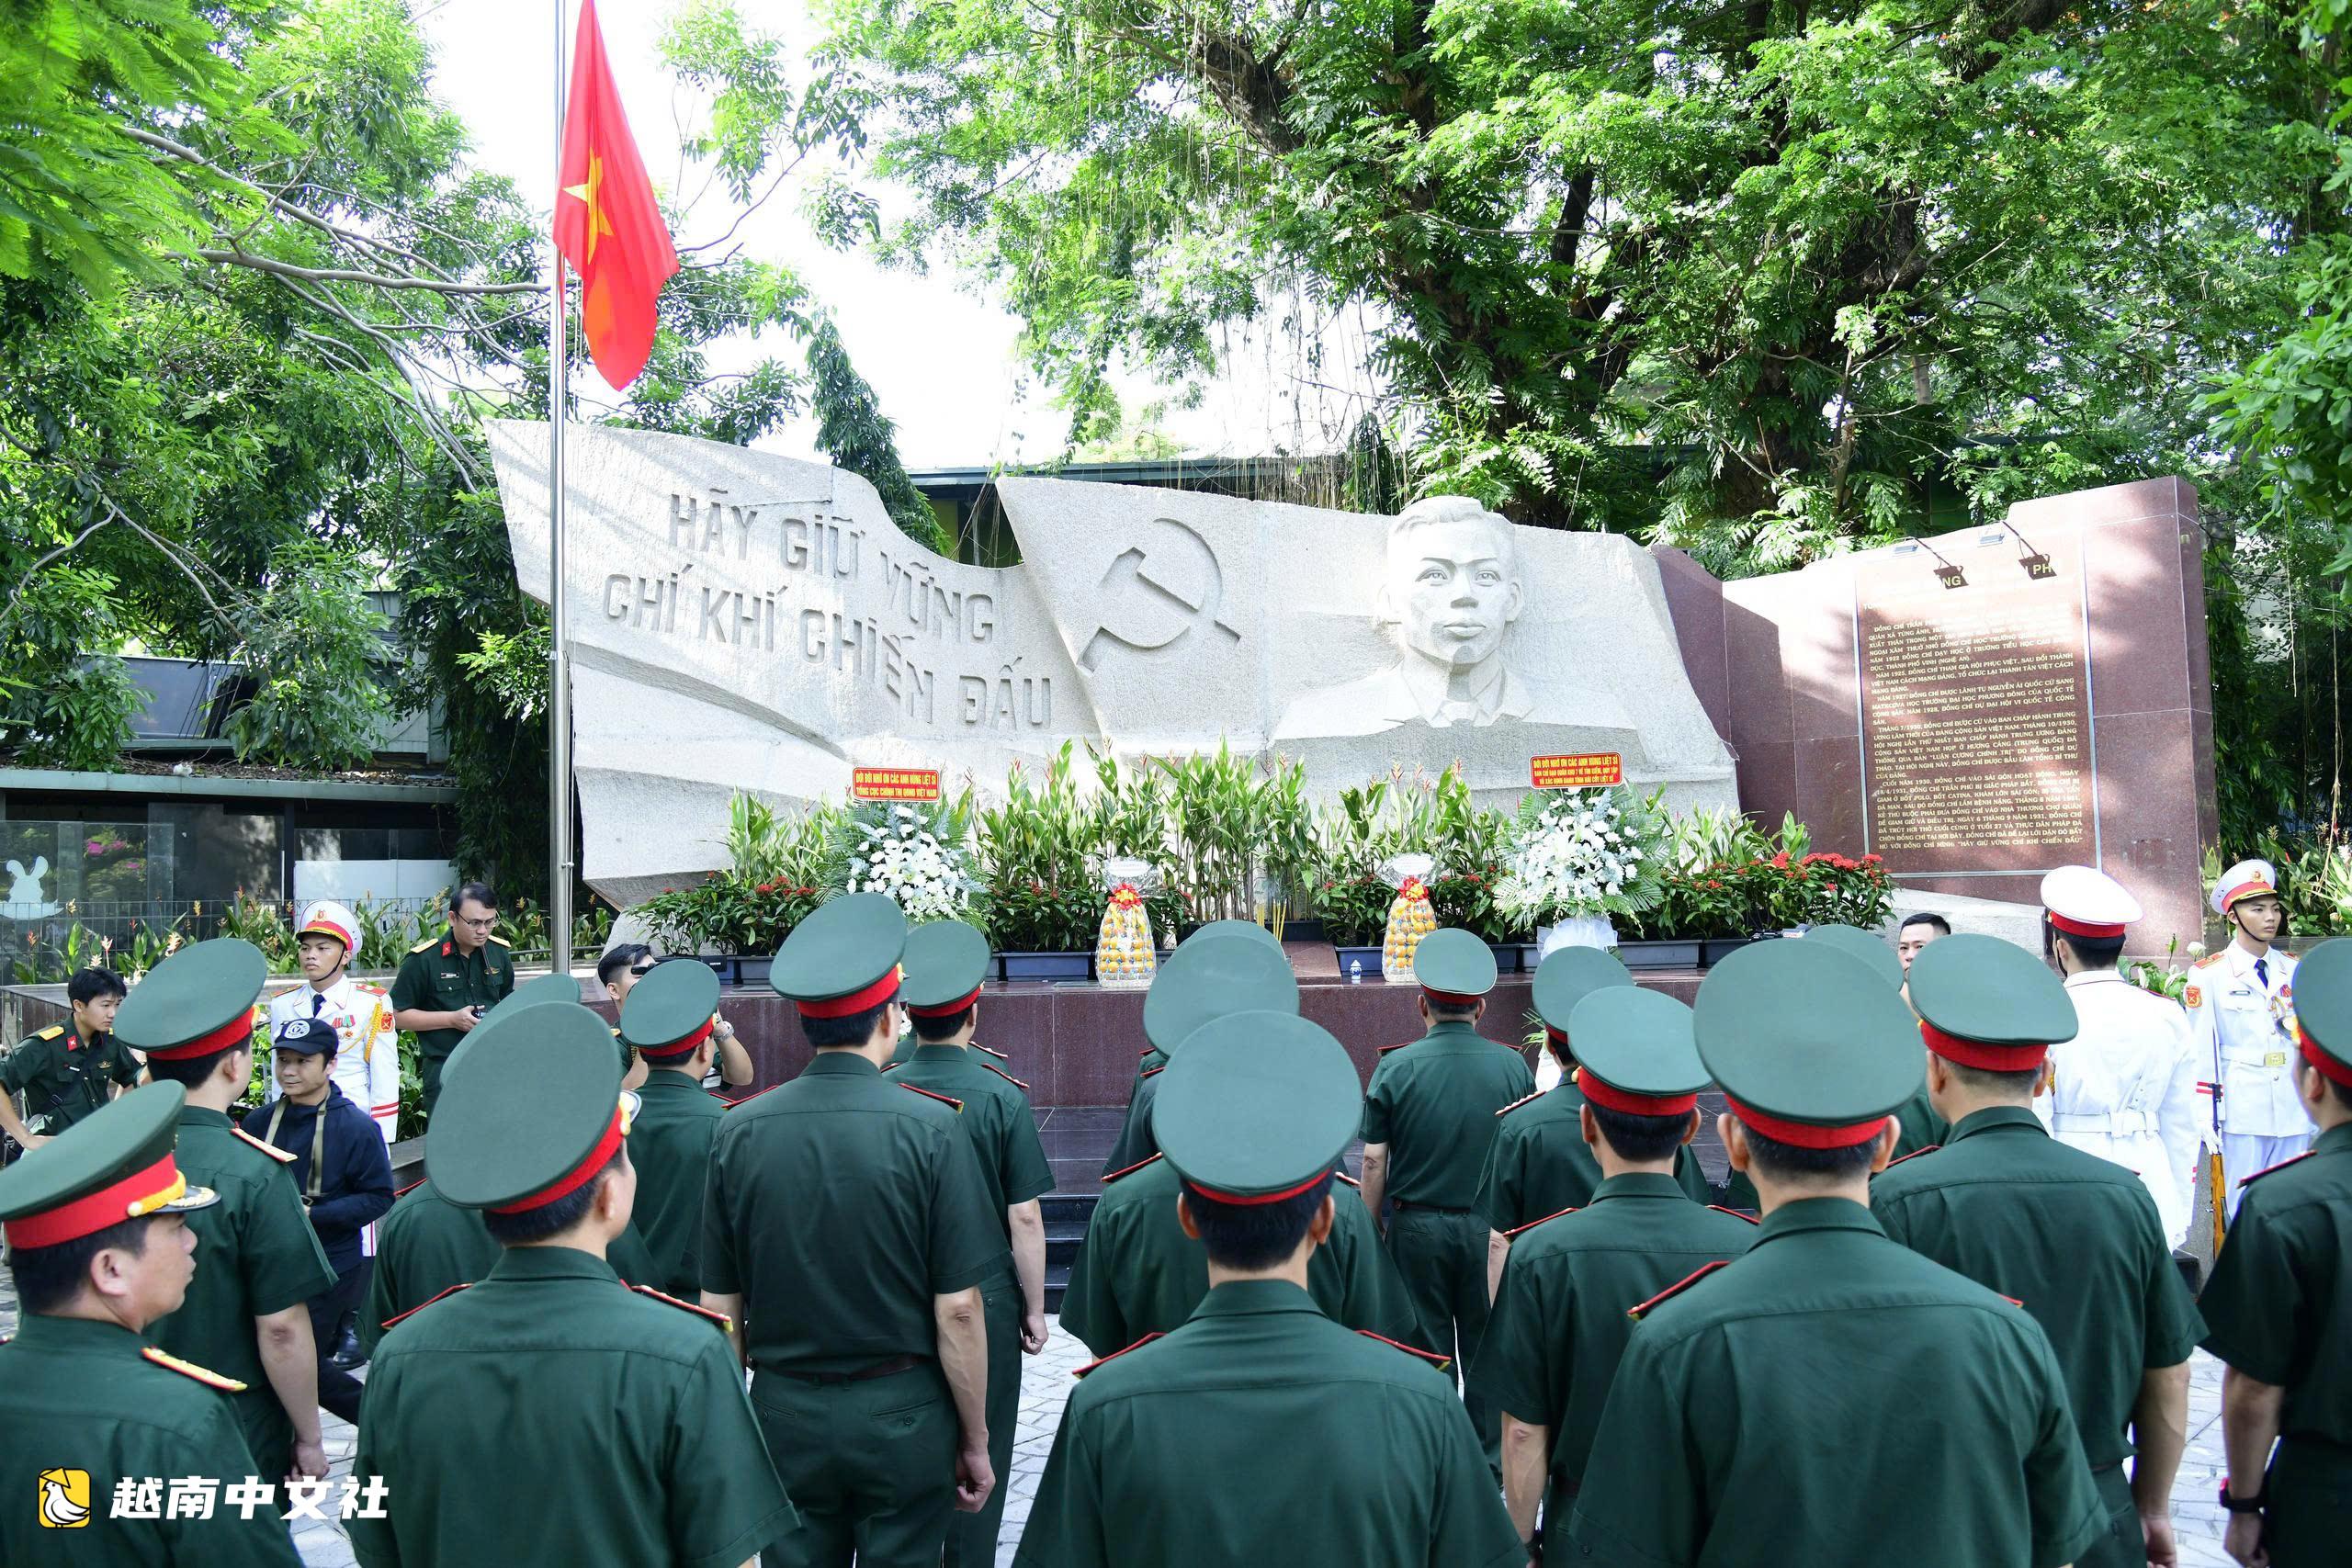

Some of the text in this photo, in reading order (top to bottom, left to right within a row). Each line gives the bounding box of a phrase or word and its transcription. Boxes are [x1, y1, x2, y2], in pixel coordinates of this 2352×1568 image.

[670, 488, 993, 643] HÃY GIỮ VỮNG
[604, 563, 1052, 730] CHÍ KHÍ CHIẾN ĐẤU
